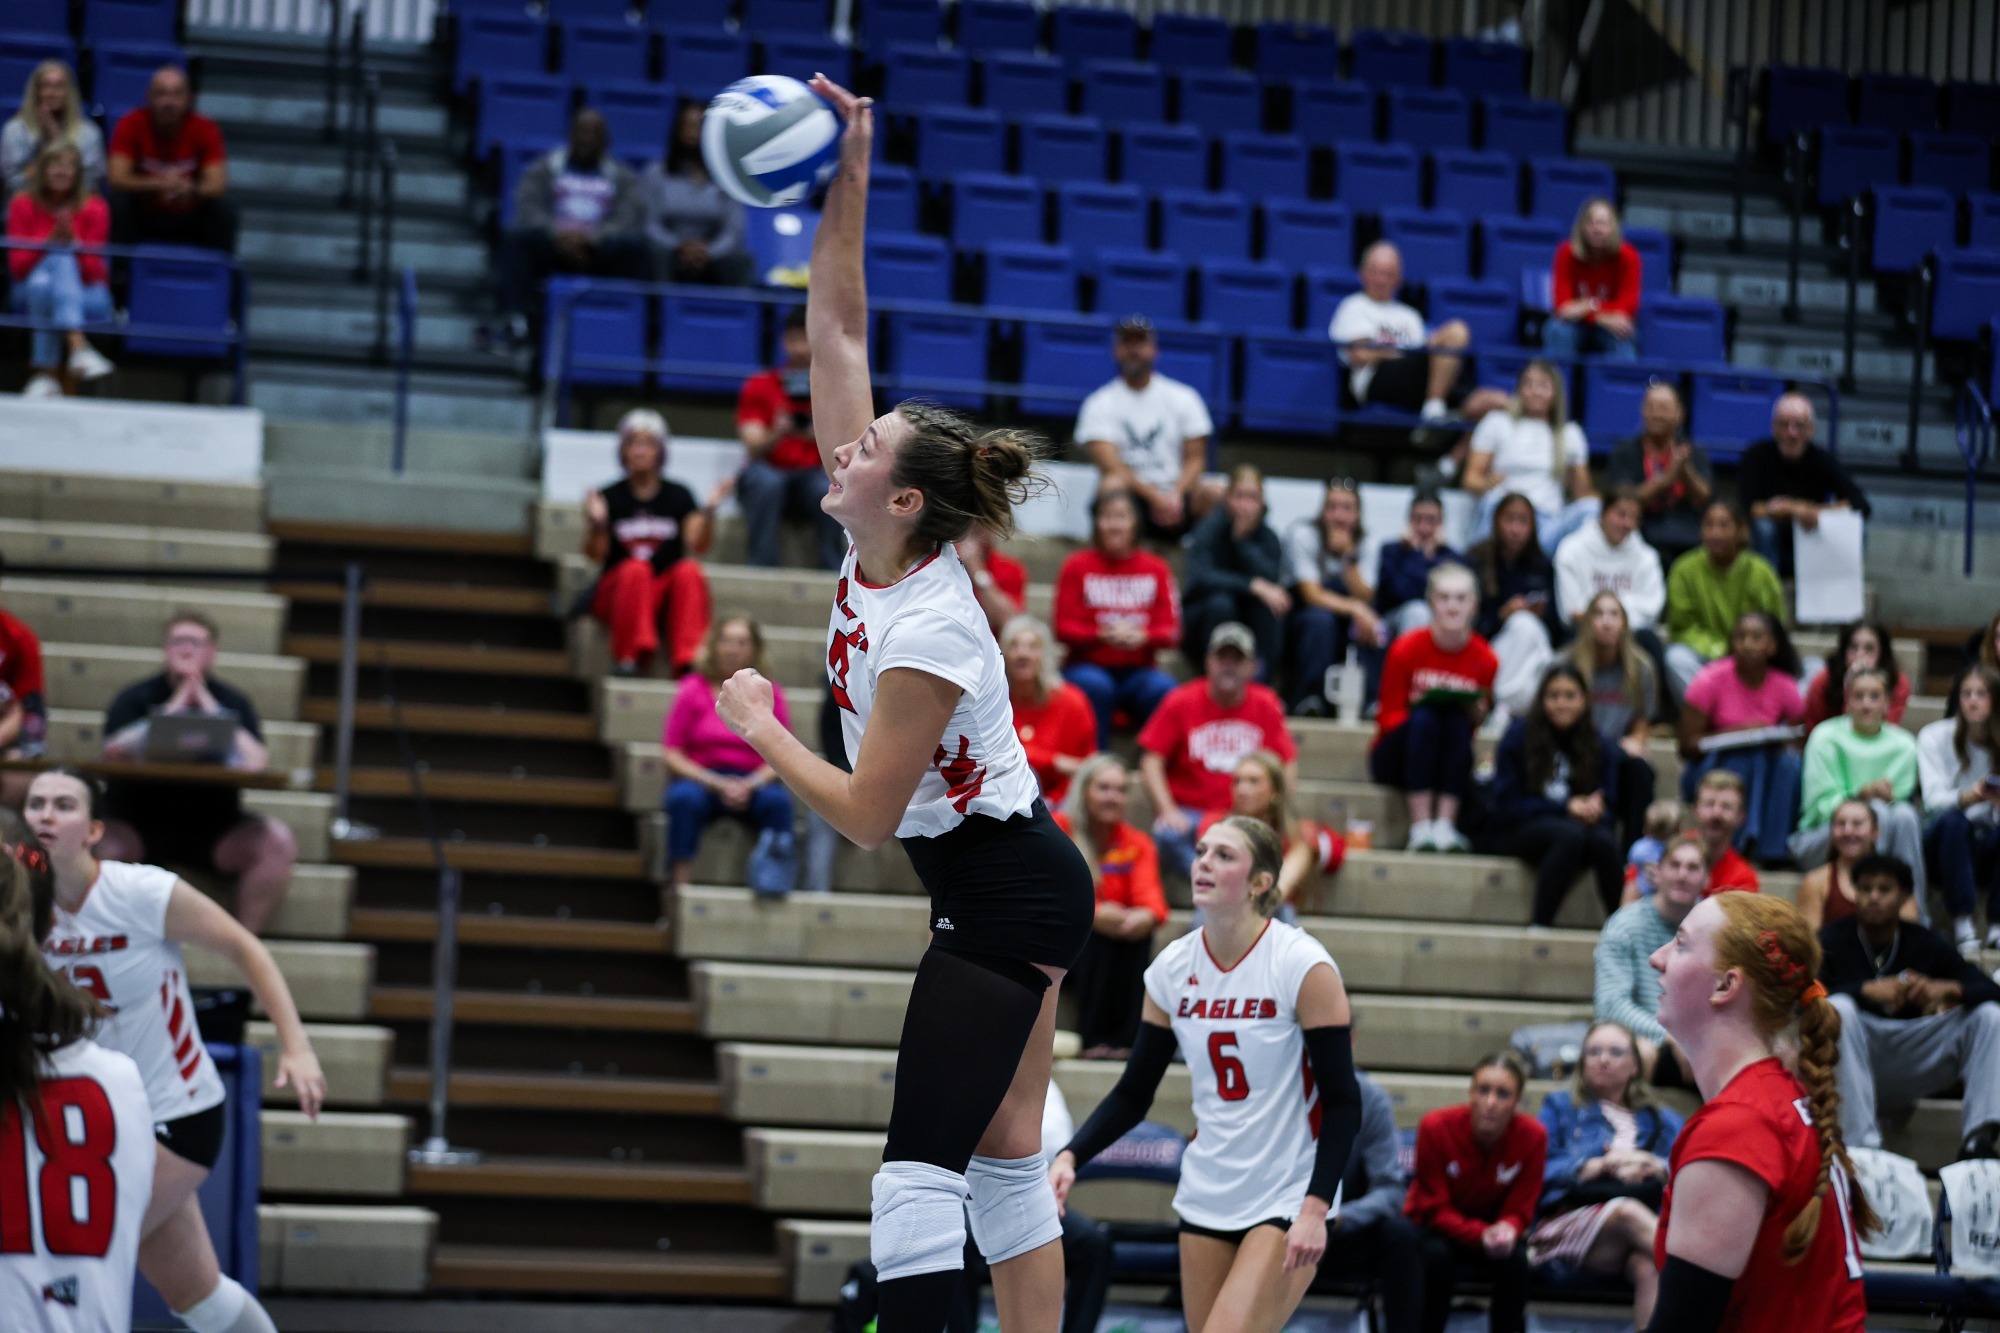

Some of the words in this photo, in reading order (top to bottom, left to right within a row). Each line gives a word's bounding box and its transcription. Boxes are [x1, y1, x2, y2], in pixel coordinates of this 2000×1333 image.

[41, 935, 128, 956] AGLES
[1177, 997, 1277, 1019] EAGLES
[1207, 1031, 1251, 1101] 6
[0, 1074, 118, 1257] 18
